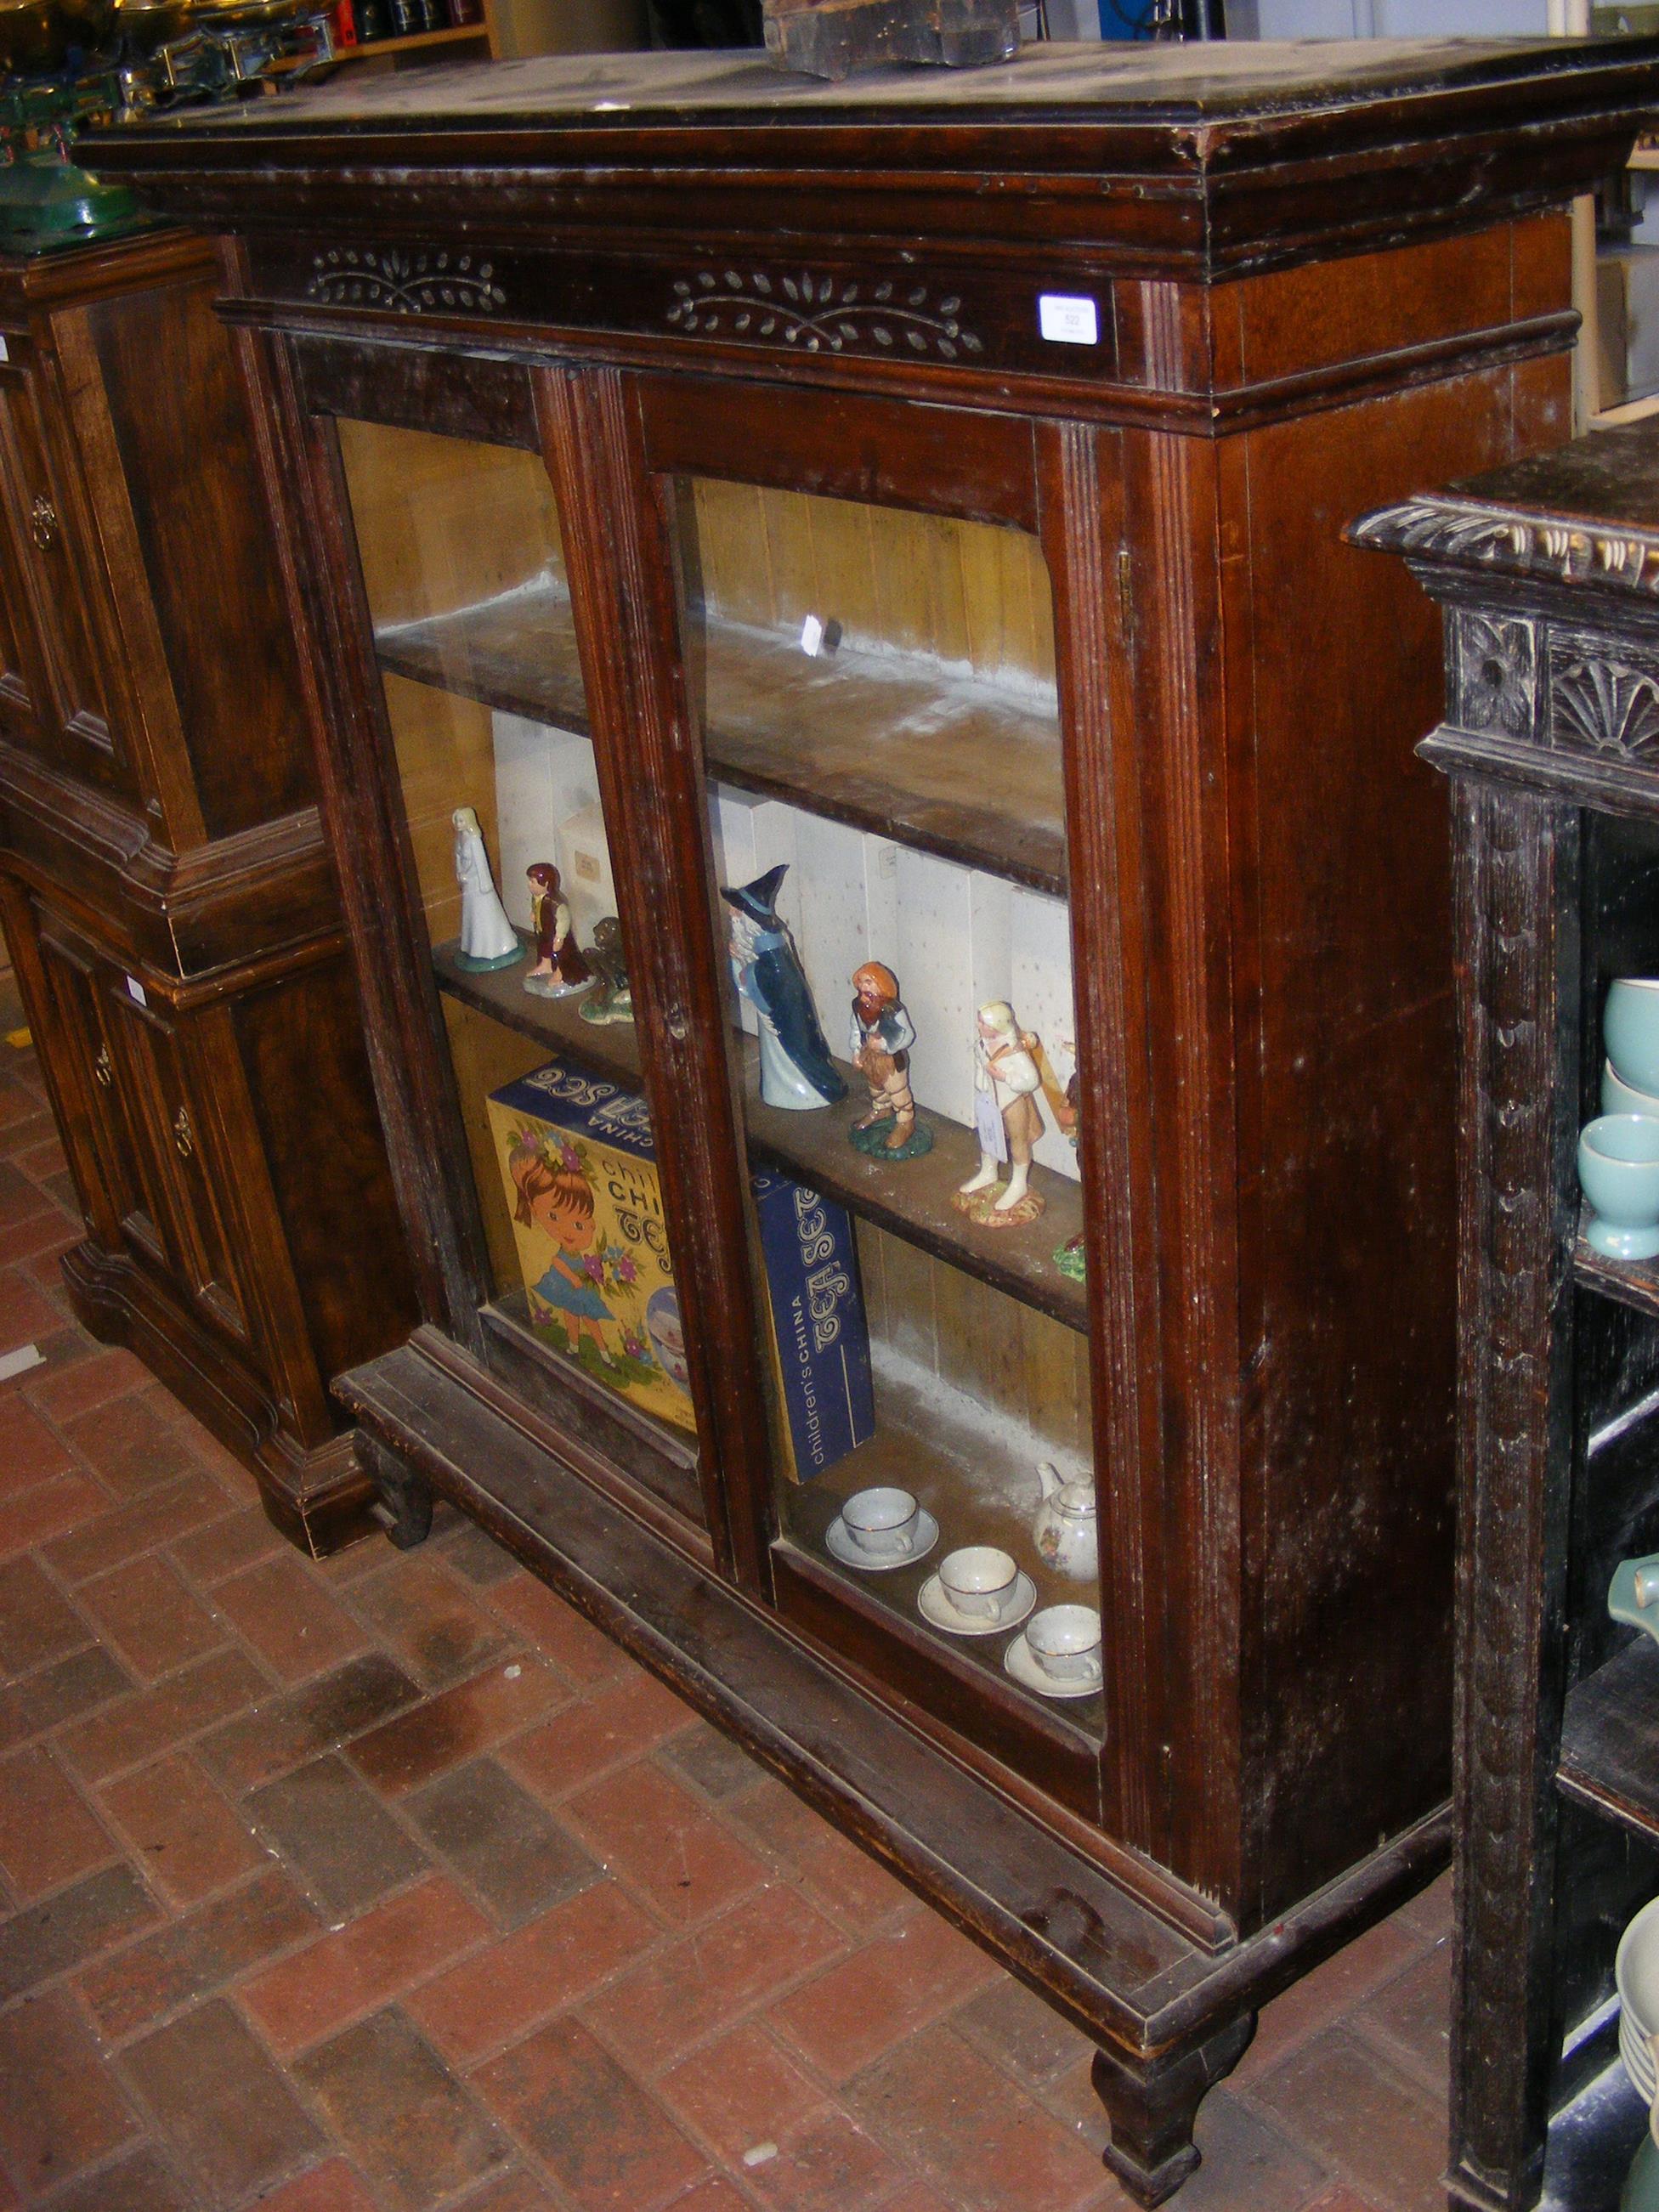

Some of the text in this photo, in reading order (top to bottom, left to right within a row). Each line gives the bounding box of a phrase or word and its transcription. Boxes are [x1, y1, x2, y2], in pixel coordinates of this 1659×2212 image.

[587, 1116, 654, 1147] CHINA
[806, 1262, 850, 1354] TEA
[792, 1294, 823, 1465] children's CHINA
